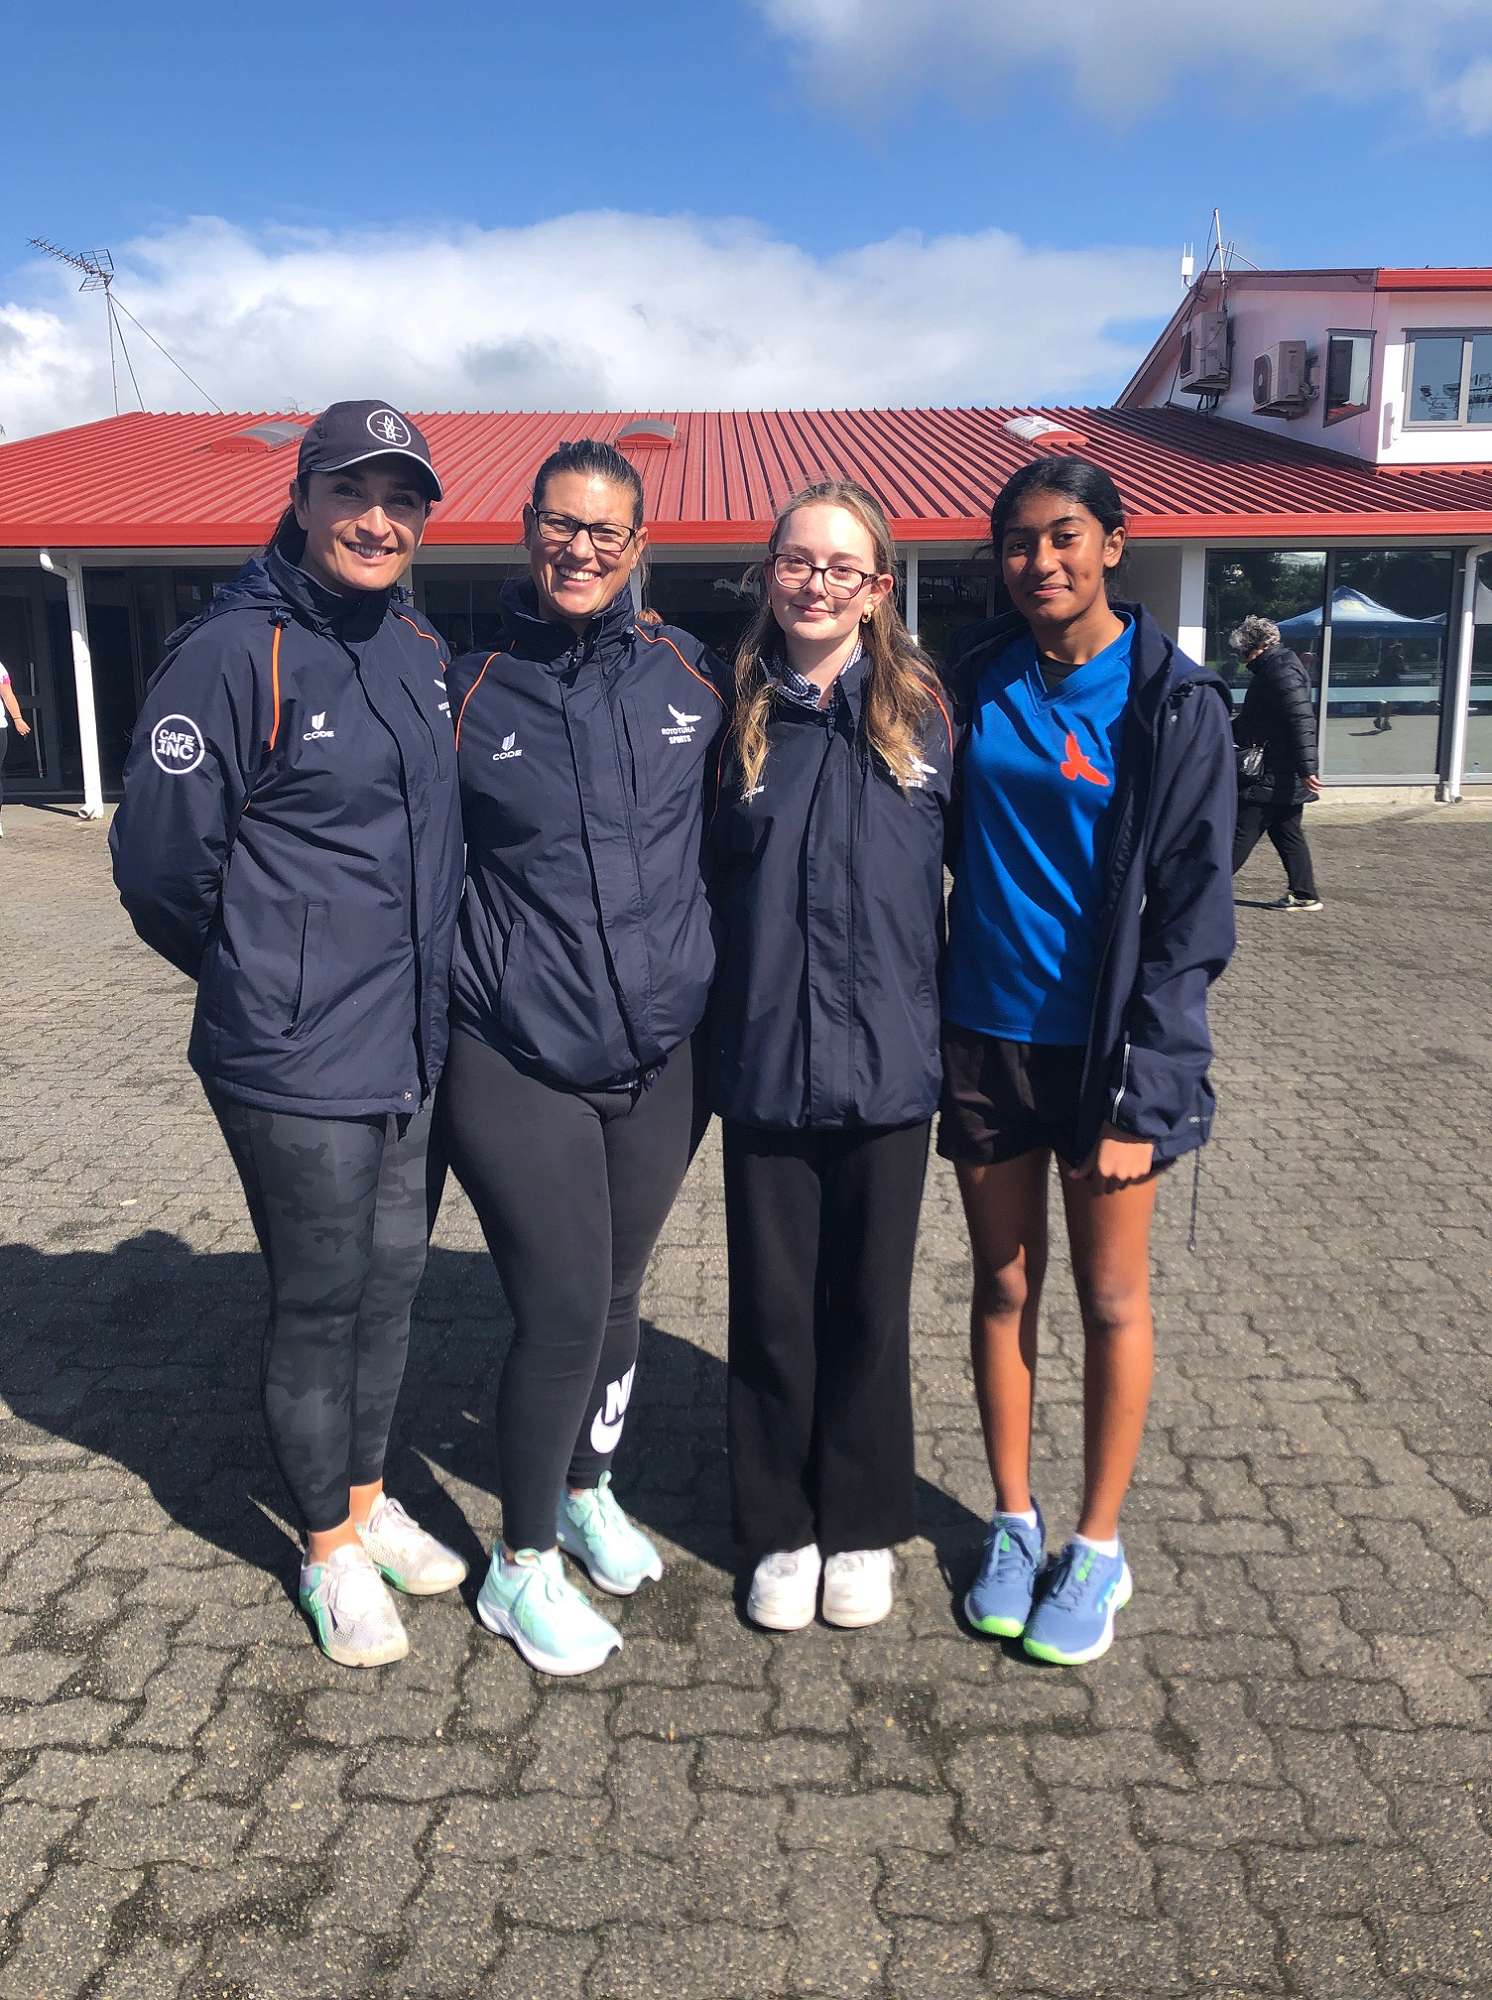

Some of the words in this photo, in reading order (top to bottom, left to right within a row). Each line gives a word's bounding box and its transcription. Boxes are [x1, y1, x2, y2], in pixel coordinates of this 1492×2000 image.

[160, 729, 195, 747] CAFE
[303, 730, 335, 741] CODE
[157, 739, 194, 760] INC
[493, 749, 522, 760] CODE
